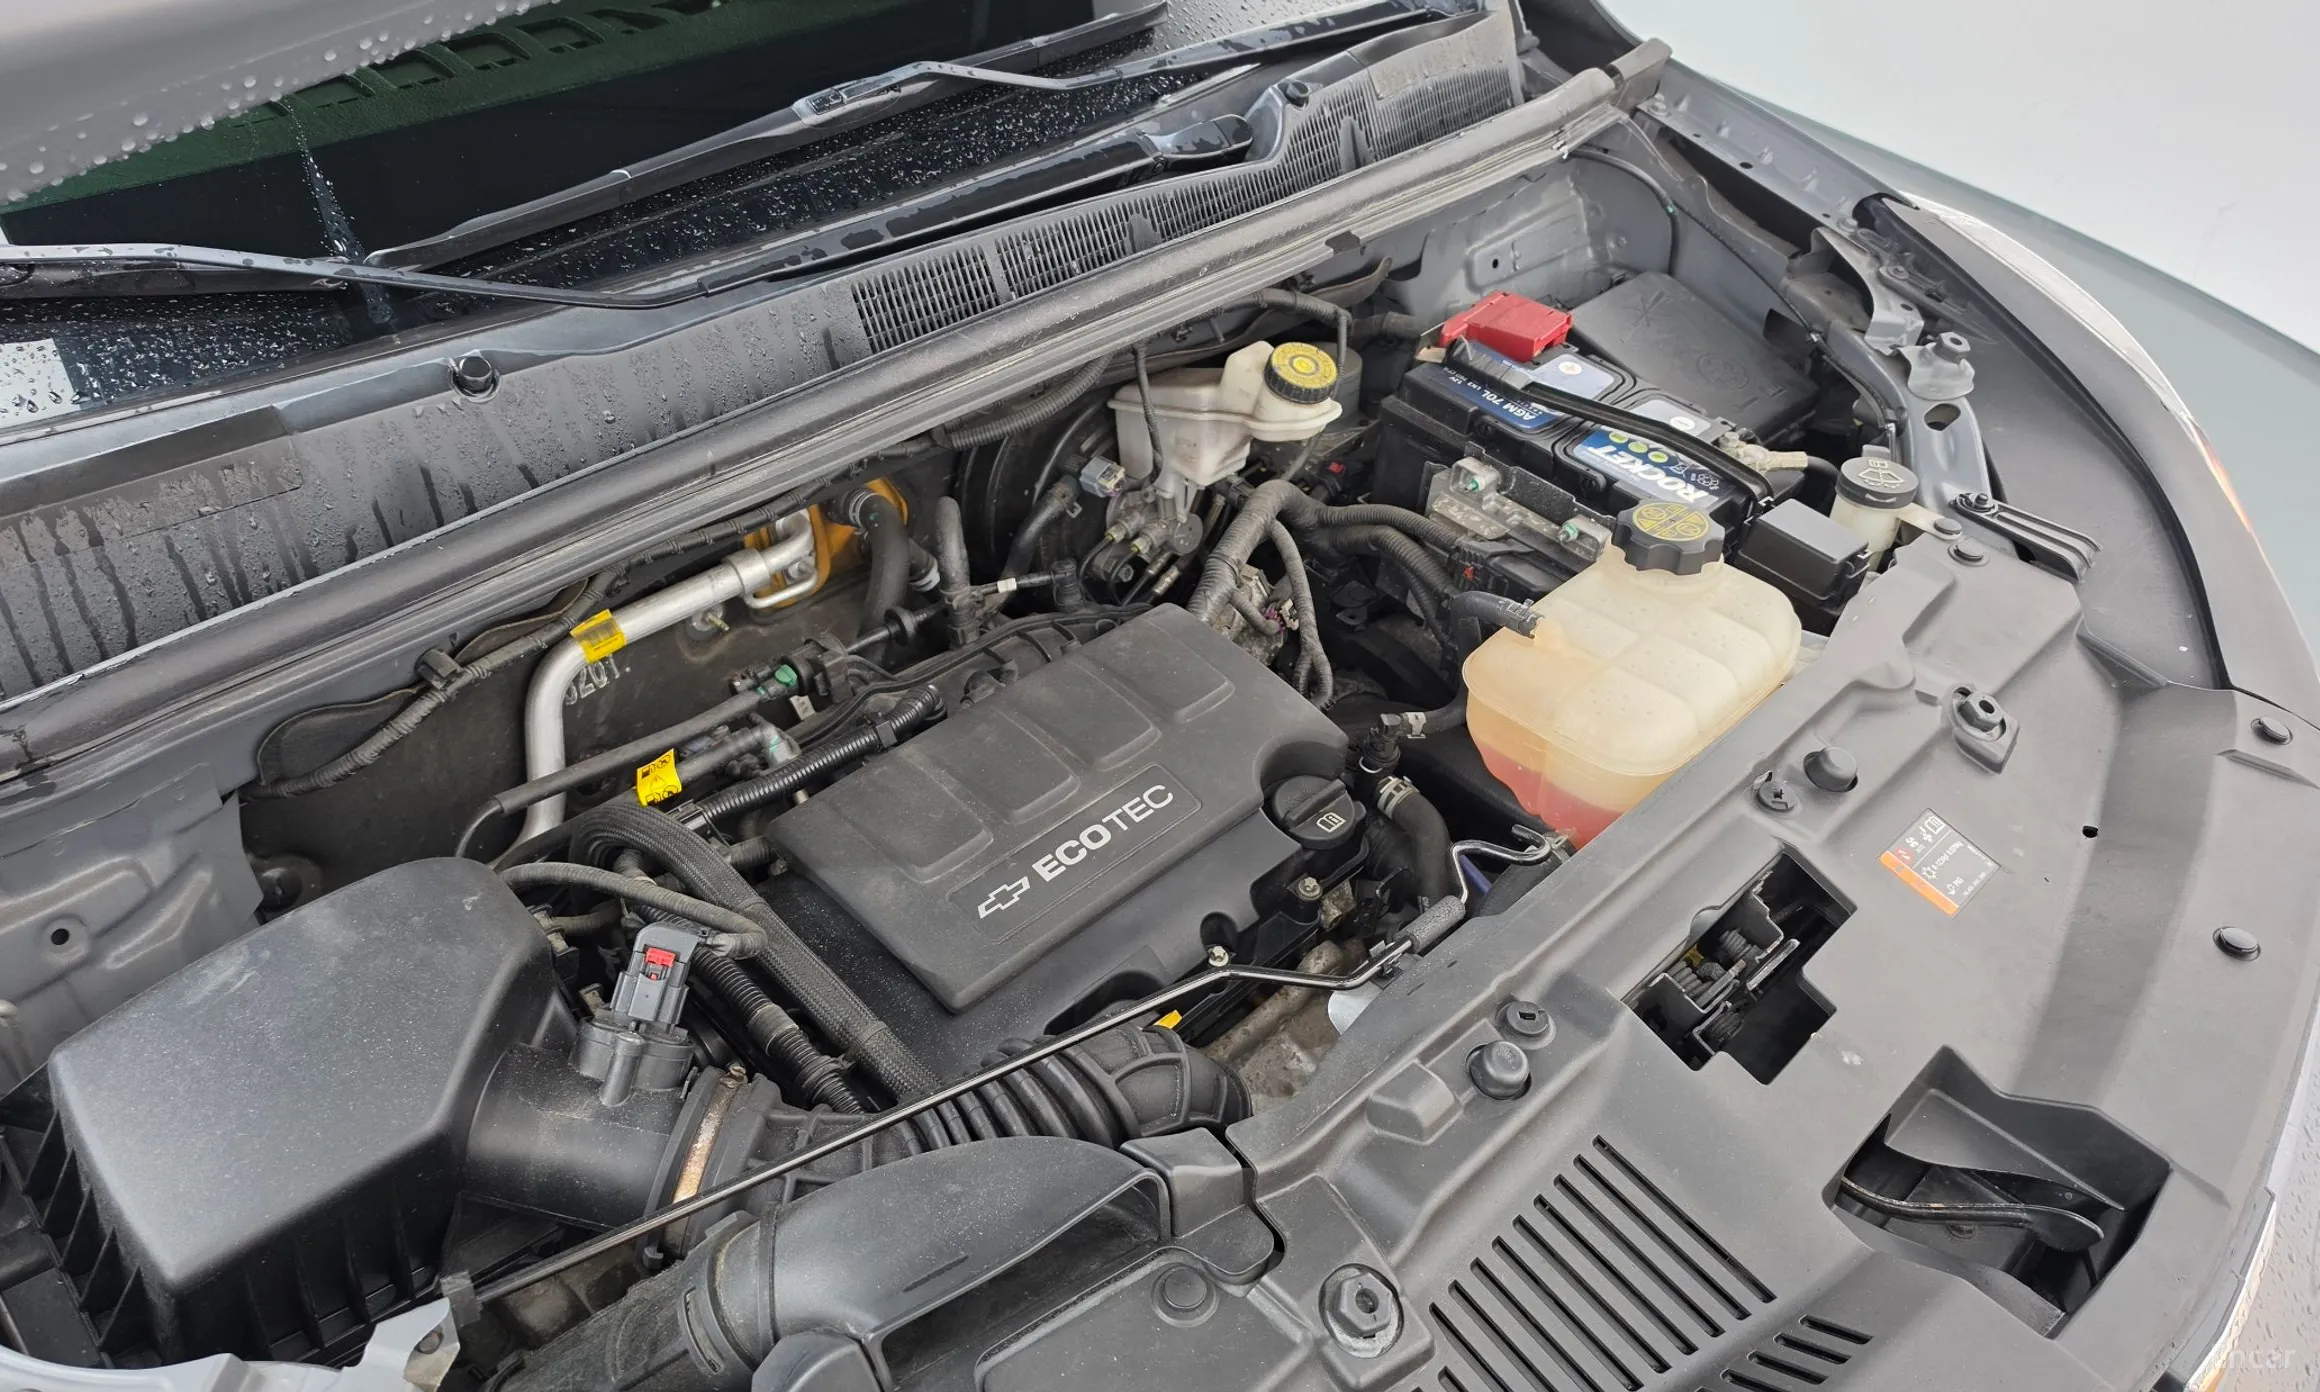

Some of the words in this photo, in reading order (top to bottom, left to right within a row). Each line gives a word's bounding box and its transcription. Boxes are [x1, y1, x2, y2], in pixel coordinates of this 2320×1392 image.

[1481, 389, 1504, 405] 70L
[1502, 401, 1536, 421] AGM
[1588, 445, 1709, 502] ROCKET
[1032, 784, 1174, 882] ECOTEC
